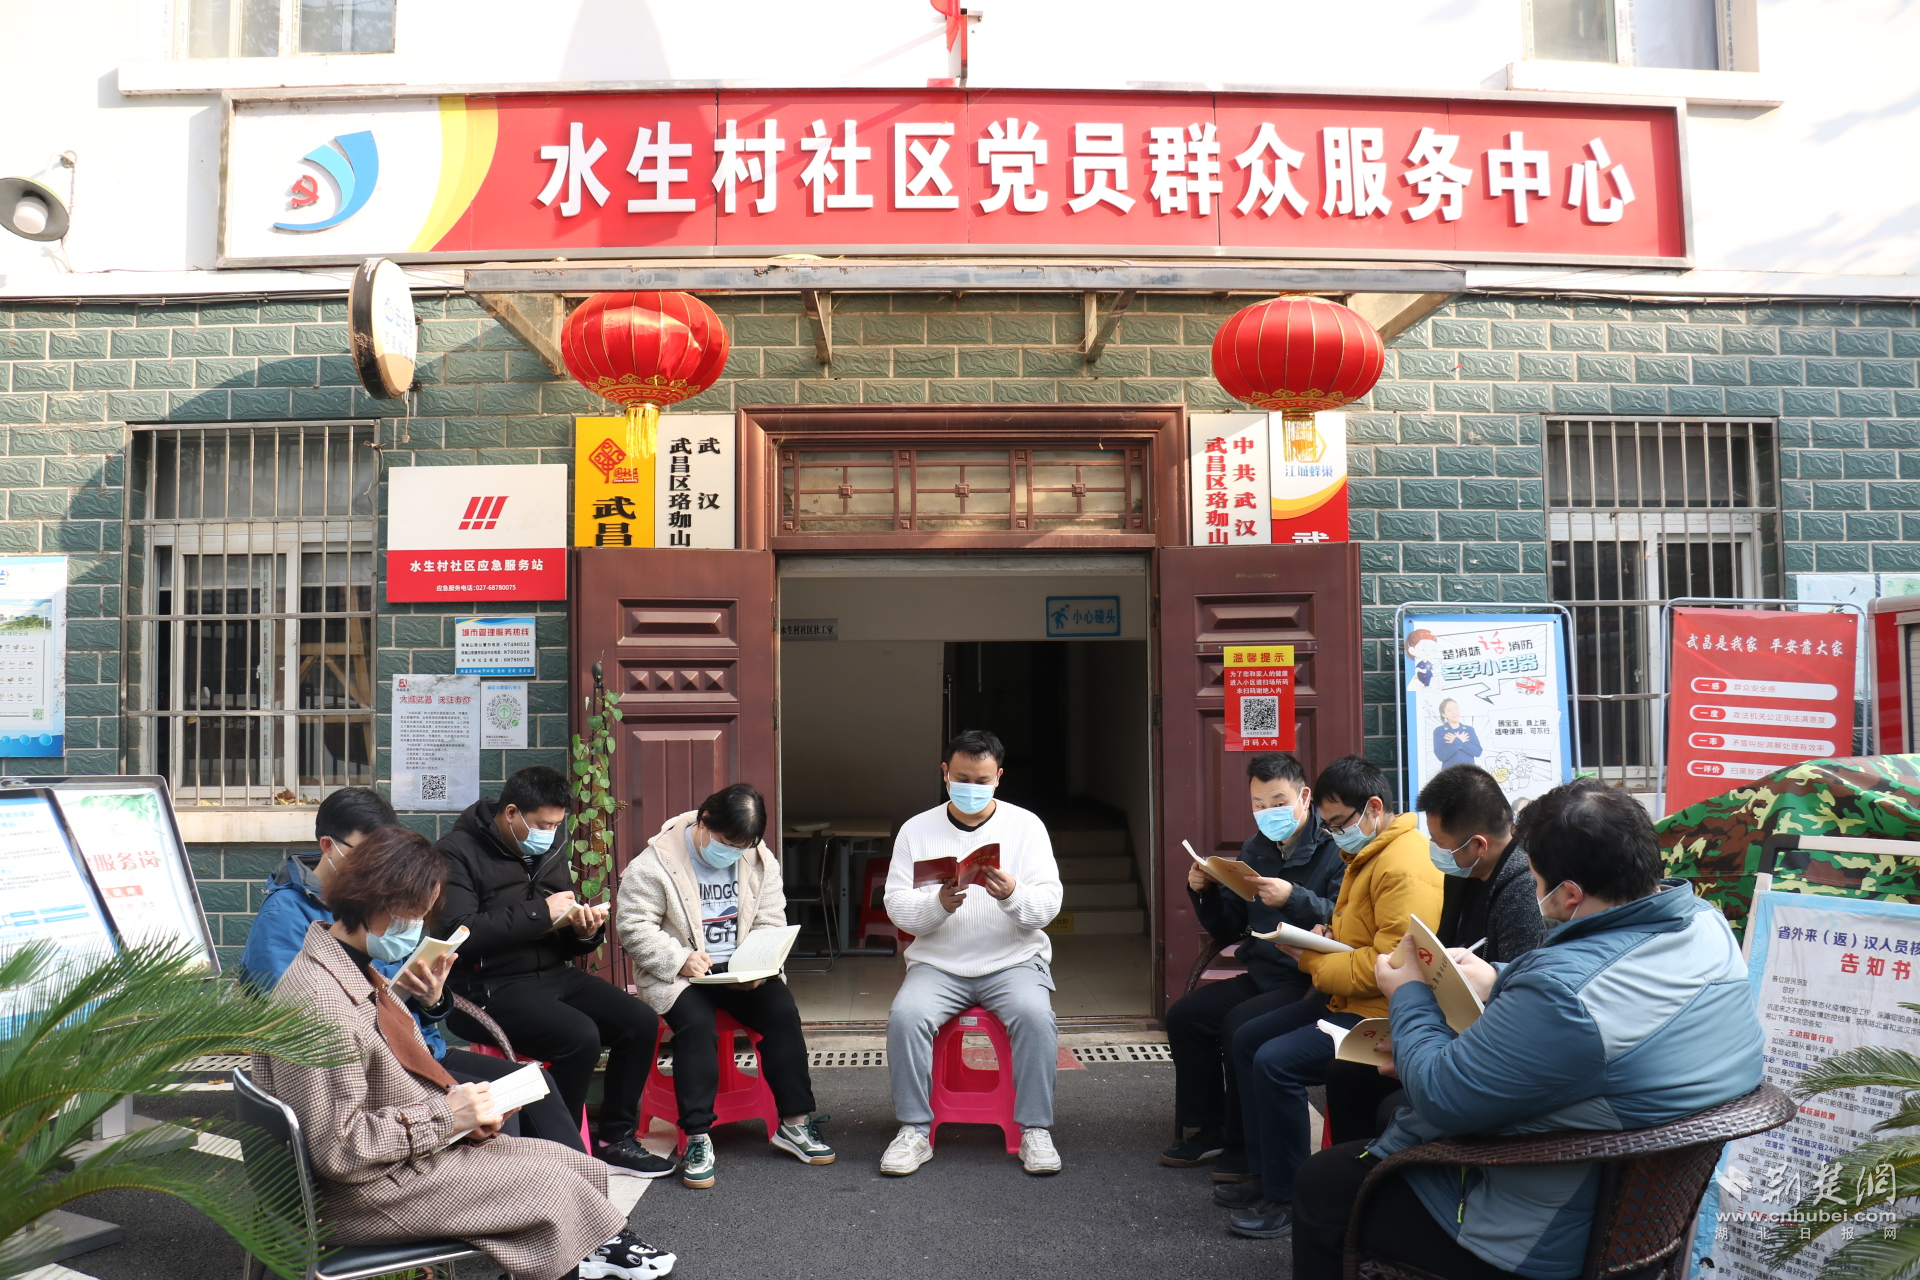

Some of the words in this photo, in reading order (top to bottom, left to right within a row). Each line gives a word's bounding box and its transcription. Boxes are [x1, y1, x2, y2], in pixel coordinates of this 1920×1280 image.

[537, 118, 1635, 224] 水生村社区党员群众服务中心
[698, 437, 720, 510] 武汉
[1285, 465, 1333, 477] 江城蜂巢
[669, 437, 692, 547] 武昌区珞珈山
[1205, 437, 1229, 545] 武昌区珞珈山
[1233, 437, 1257, 536] 中共武汉
[410, 559, 544, 572] 水生村社区应急服务站
[1073, 609, 1116, 625] 小心碰头
[462, 628, 529, 637] 城市管理服务热线
[1686, 633, 1758, 653] 武昌是我家
[1770, 637, 1844, 657] 平安靠大家
[1233, 653, 1284, 663] 温馨提示
[1441, 653, 1539, 681] 冬季小电器
[1734, 683, 1776, 693] 群众安全感
[1733, 711, 1826, 725] 政法机关公正执法满意度
[1243, 739, 1278, 747] 扫码入内
[1695, 764, 1720, 774] 一评价
[1840, 953, 1911, 981] 告知书
